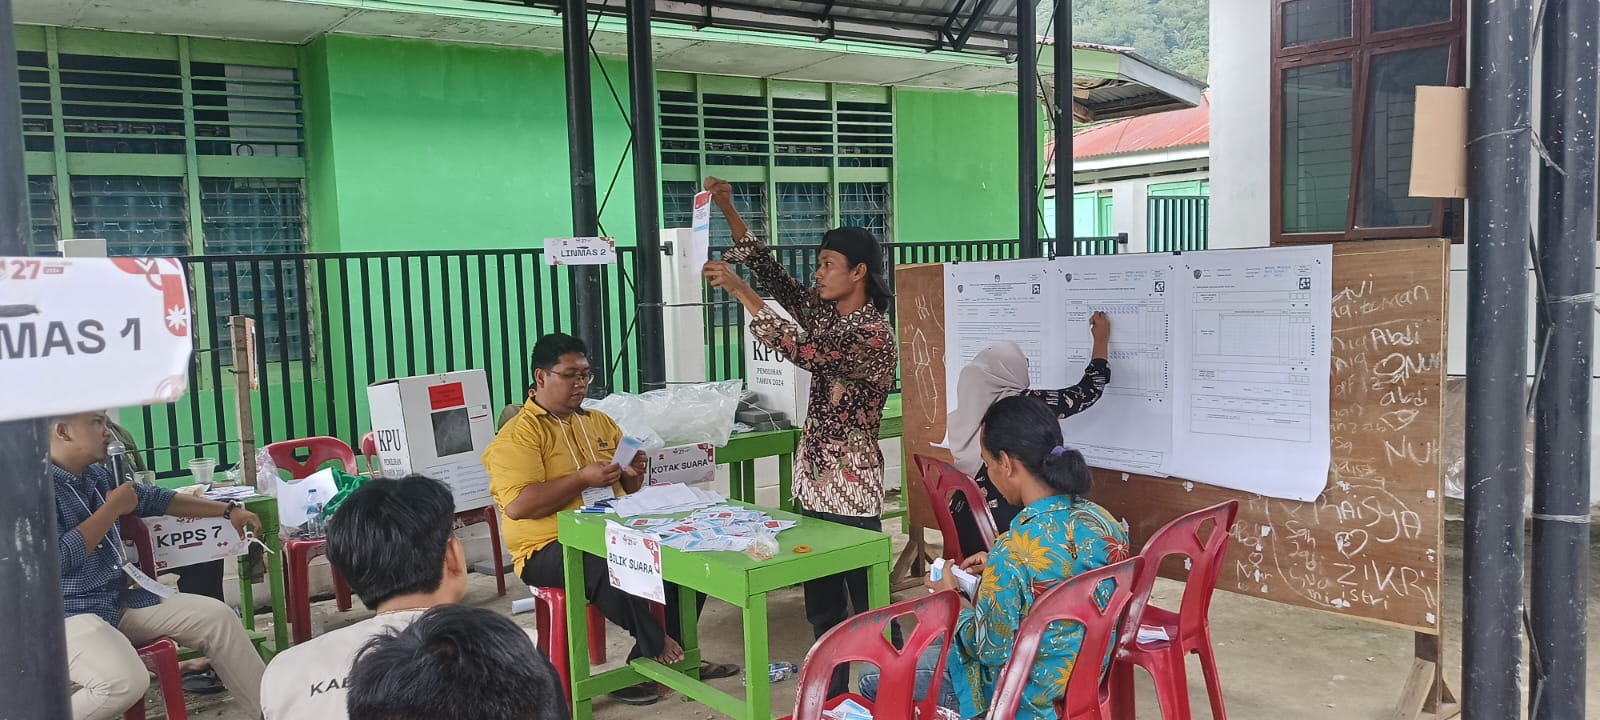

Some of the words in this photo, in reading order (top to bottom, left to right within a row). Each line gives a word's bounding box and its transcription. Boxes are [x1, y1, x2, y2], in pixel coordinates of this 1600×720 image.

[560, 248, 598, 257] LINMAS
[600, 248, 607, 256] 2
[10, 259, 41, 280] 27
[120, 317, 142, 351] 1
[377, 429, 401, 452] KPU
[651, 463, 680, 474] KOTAK
[681, 458, 709, 470] SUARA
[156, 528, 207, 548] KPPS
[211, 525, 222, 539] 7
[608, 552, 628, 568] BILIK
[628, 559, 654, 576] SUARA
